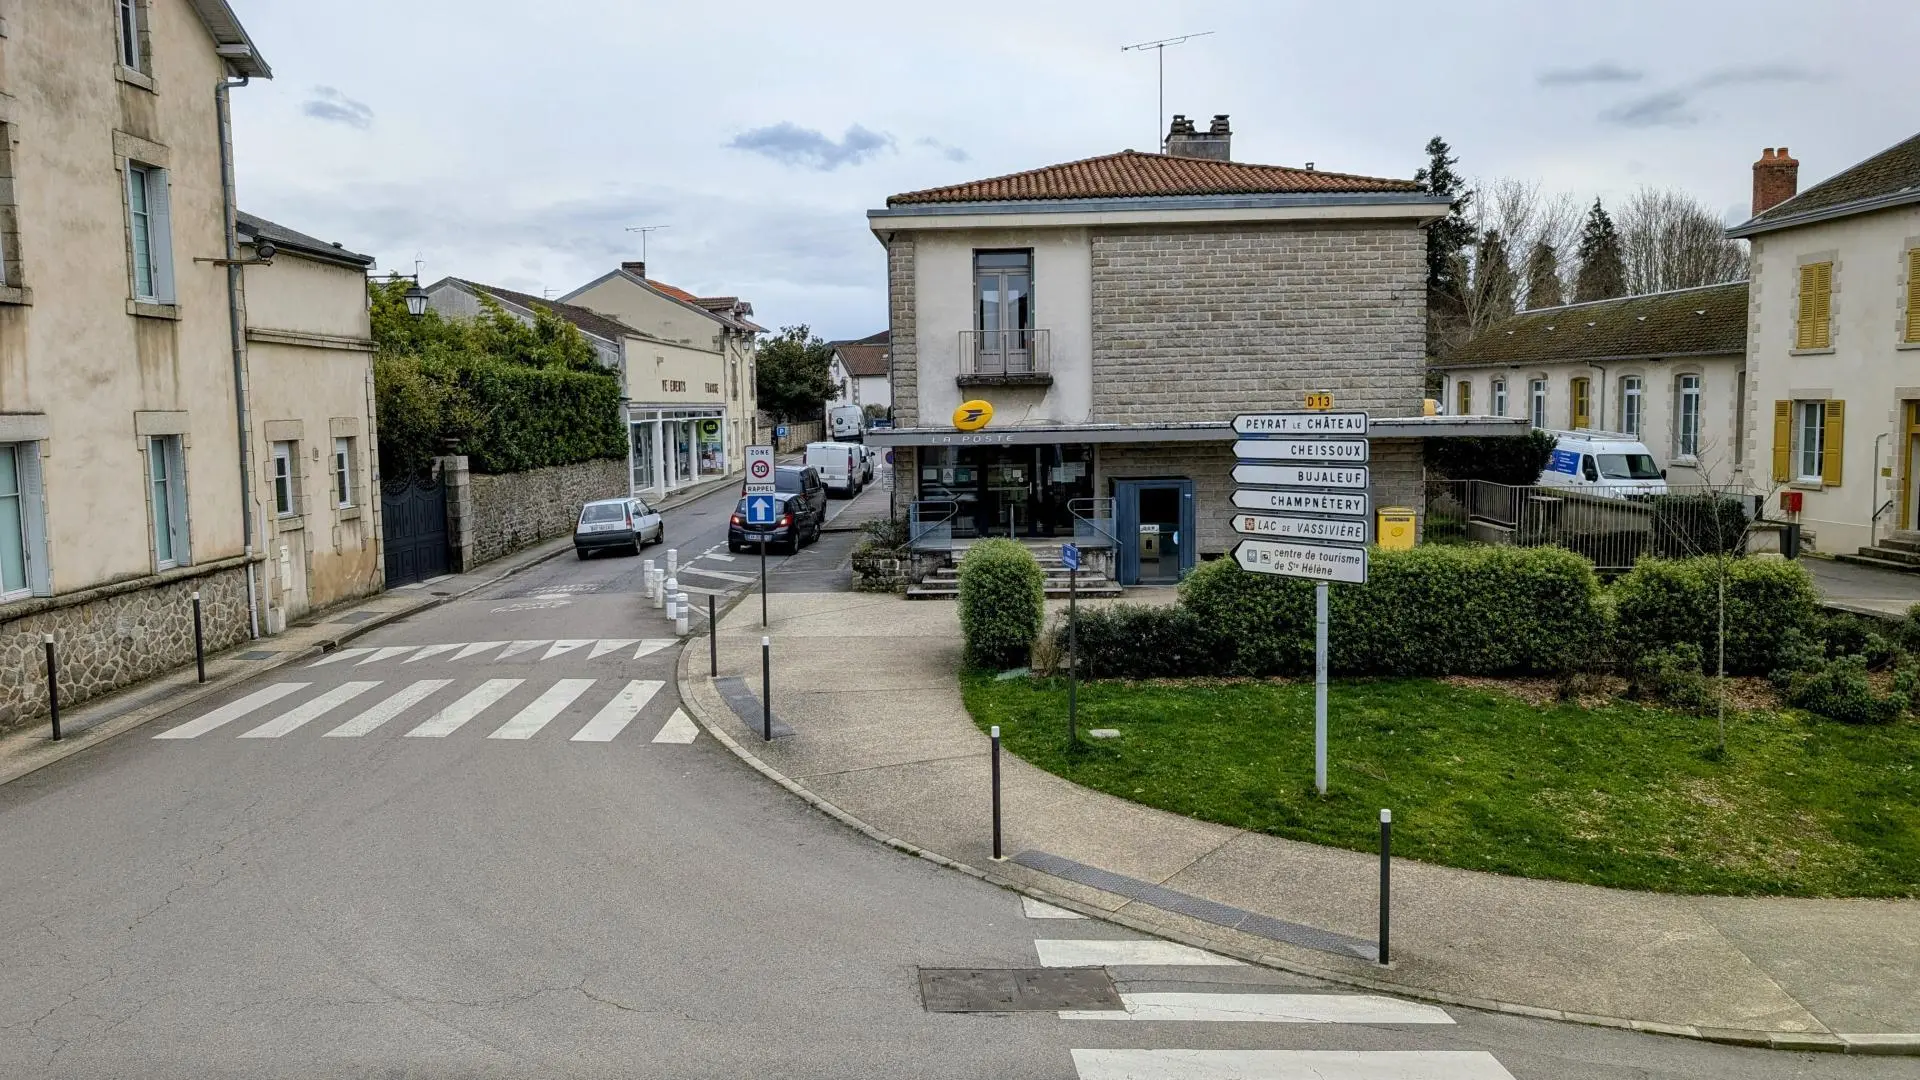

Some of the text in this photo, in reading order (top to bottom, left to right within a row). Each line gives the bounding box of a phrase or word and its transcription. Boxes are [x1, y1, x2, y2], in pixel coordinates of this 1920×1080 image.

[1307, 396, 1330, 407] D 13
[1246, 417, 1362, 430] PEYRAT LE CHÂTEAU
[962, 435, 1014, 443] POSTE
[1290, 445, 1361, 457] CHEISSOUX
[754, 465, 766, 473] 30
[1297, 471, 1362, 483] BUJALEUF
[1271, 494, 1361, 511] CHAMPNÉTERY
[1257, 521, 1277, 531] LAC
[1297, 522, 1361, 538] VASSIVIÈRE
[1274, 549, 1360, 565] centre de tourisme
[1274, 560, 1285, 571] de
[1301, 563, 1333, 576] Hélène
